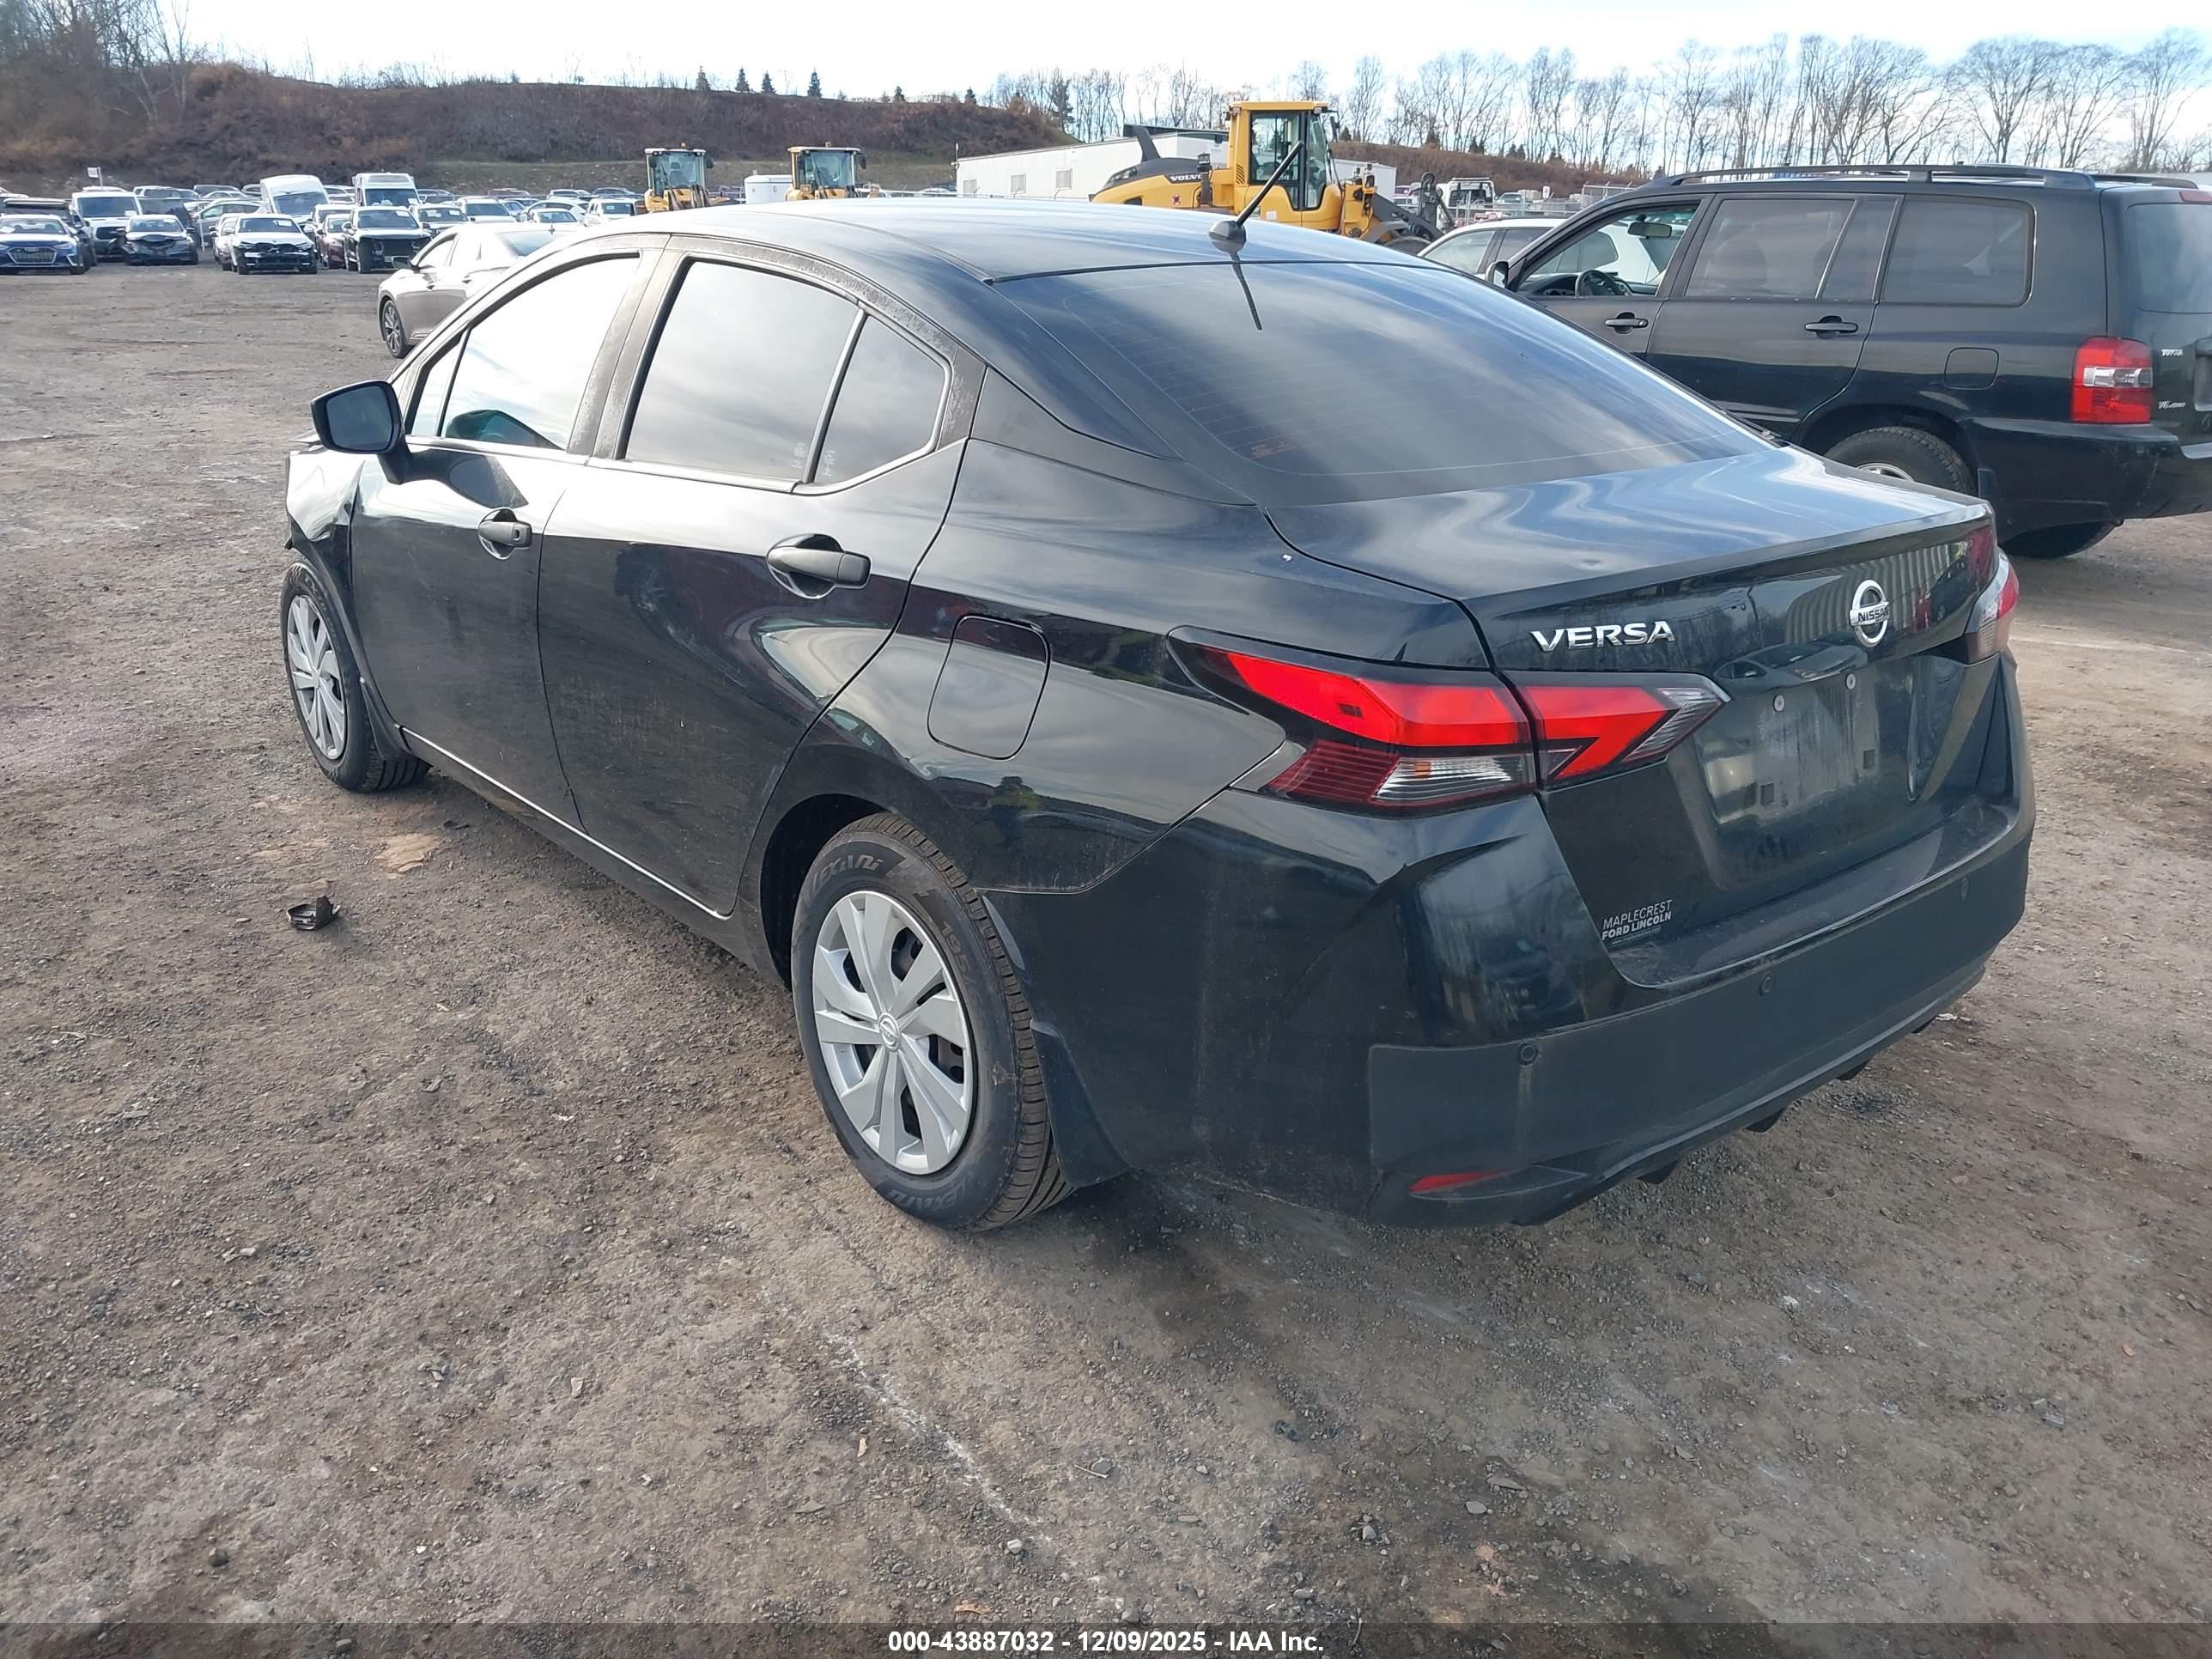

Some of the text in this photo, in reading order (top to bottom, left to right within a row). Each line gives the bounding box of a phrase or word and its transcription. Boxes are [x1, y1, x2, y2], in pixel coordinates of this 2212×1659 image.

[1530, 620, 1676, 653] VERSA
[1601, 925, 1630, 941] FORD
[1631, 911, 1673, 933] LINCOLN
[1602, 899, 1674, 930] MAPLECREST
